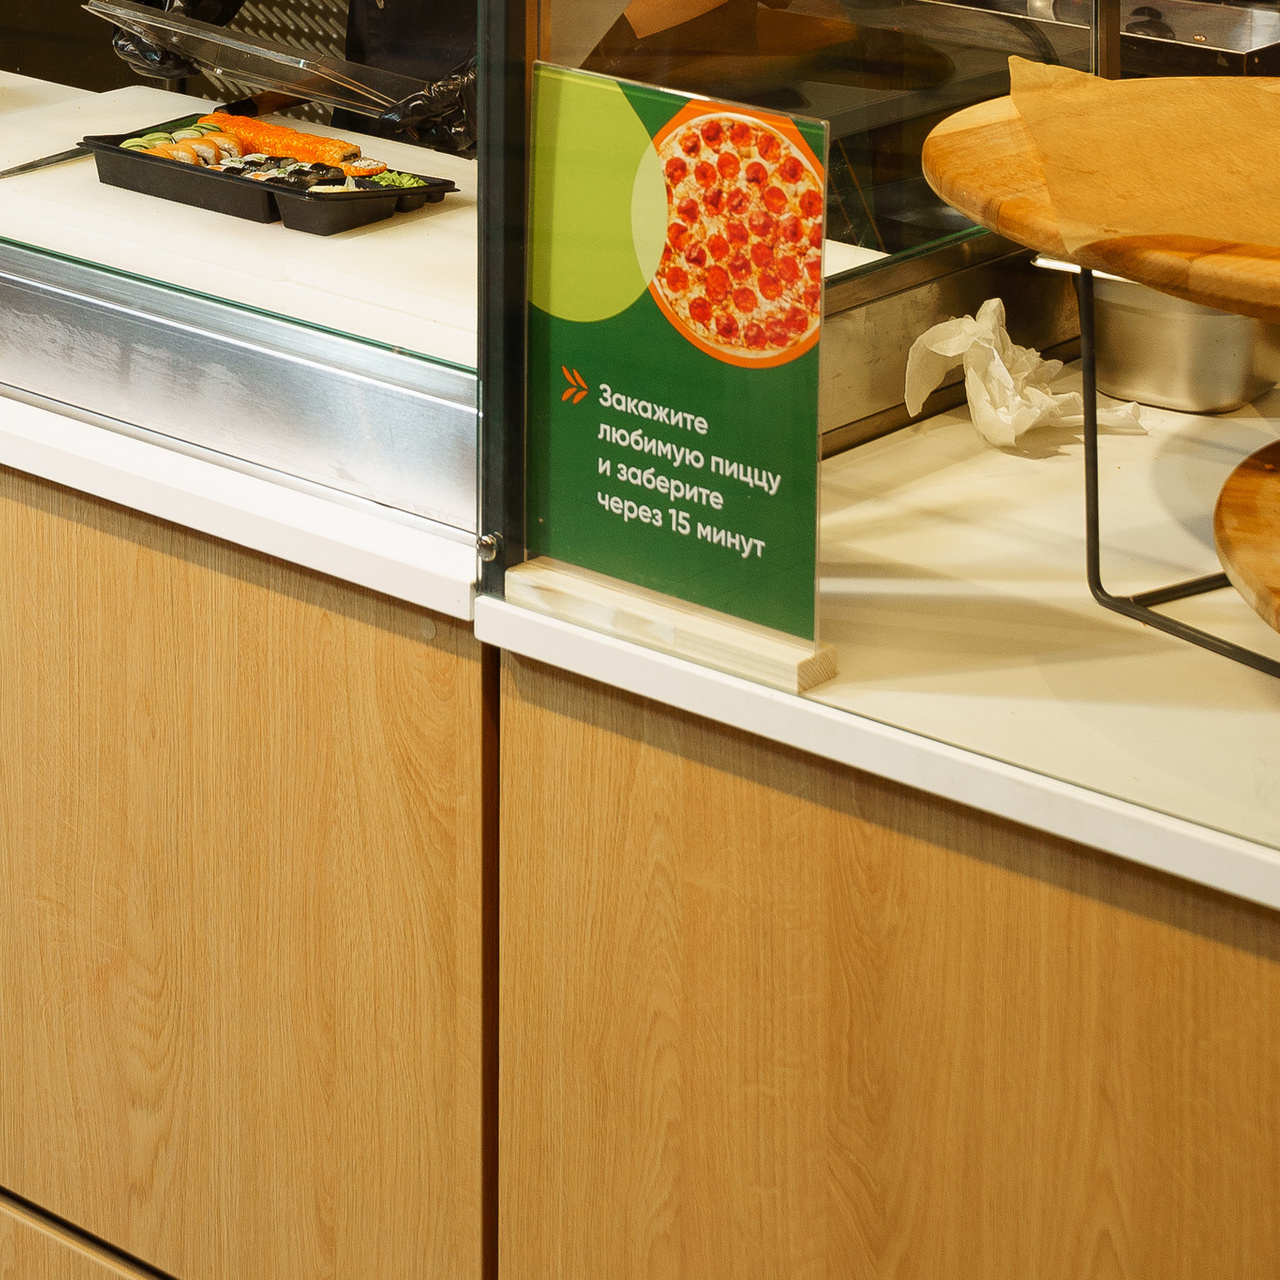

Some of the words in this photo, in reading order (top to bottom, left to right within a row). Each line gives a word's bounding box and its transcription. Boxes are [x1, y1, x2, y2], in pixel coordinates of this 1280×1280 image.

[598, 383, 709, 435] Закажите
[598, 423, 705, 468] любимую
[711, 455, 781, 495] пиццу
[598, 457, 611, 477] и
[616, 463, 724, 510] заберите
[597, 492, 663, 527] через
[668, 508, 691, 535] 15
[697, 522, 766, 559] минут
